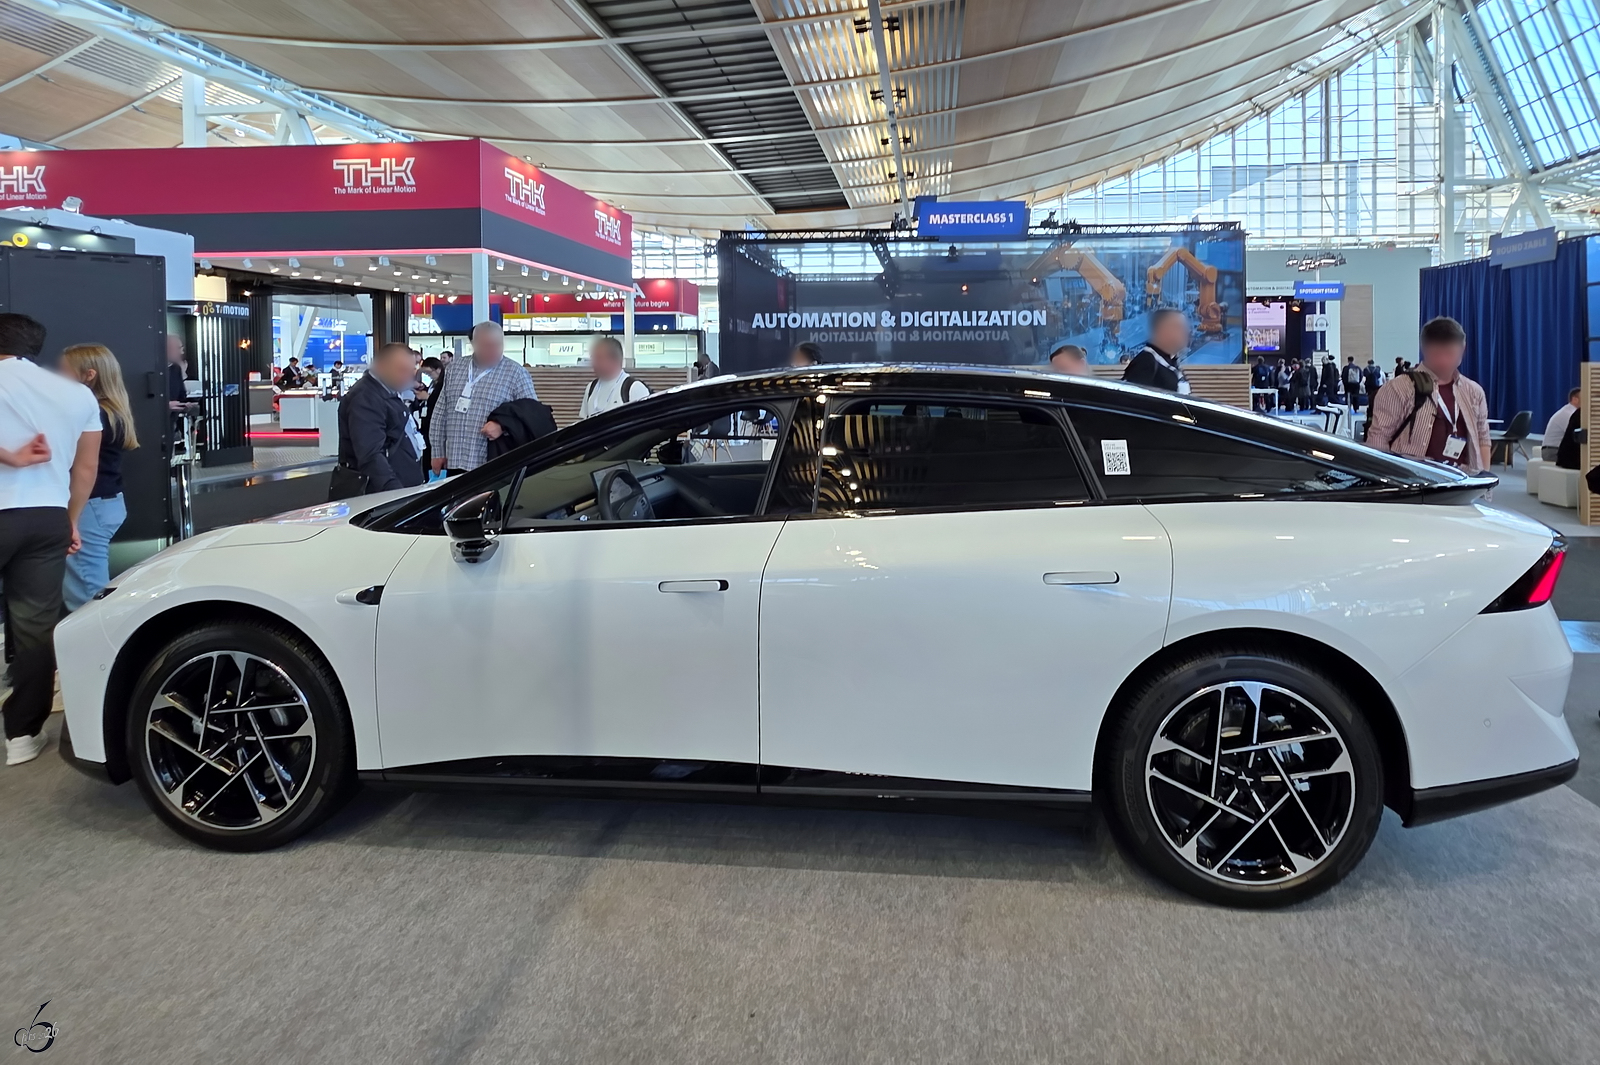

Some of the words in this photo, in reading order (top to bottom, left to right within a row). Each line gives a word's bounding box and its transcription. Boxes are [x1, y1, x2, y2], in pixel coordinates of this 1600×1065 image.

[0, 166, 46, 192] HK
[333, 157, 416, 187] THK
[364, 186, 371, 194] of
[372, 186, 393, 194] Linear
[505, 167, 545, 210] THK
[594, 209, 621, 241] THK
[929, 213, 1006, 224] MASTERCLASS
[1008, 212, 1014, 223] 1
[1496, 244, 1523, 255] ROUND
[1523, 237, 1547, 250] TABLE
[650, 300, 670, 308] begins
[752, 311, 876, 328] AUTOMATION
[881, 311, 896, 327] &
[900, 310, 1047, 327] DIGITALIZATION
